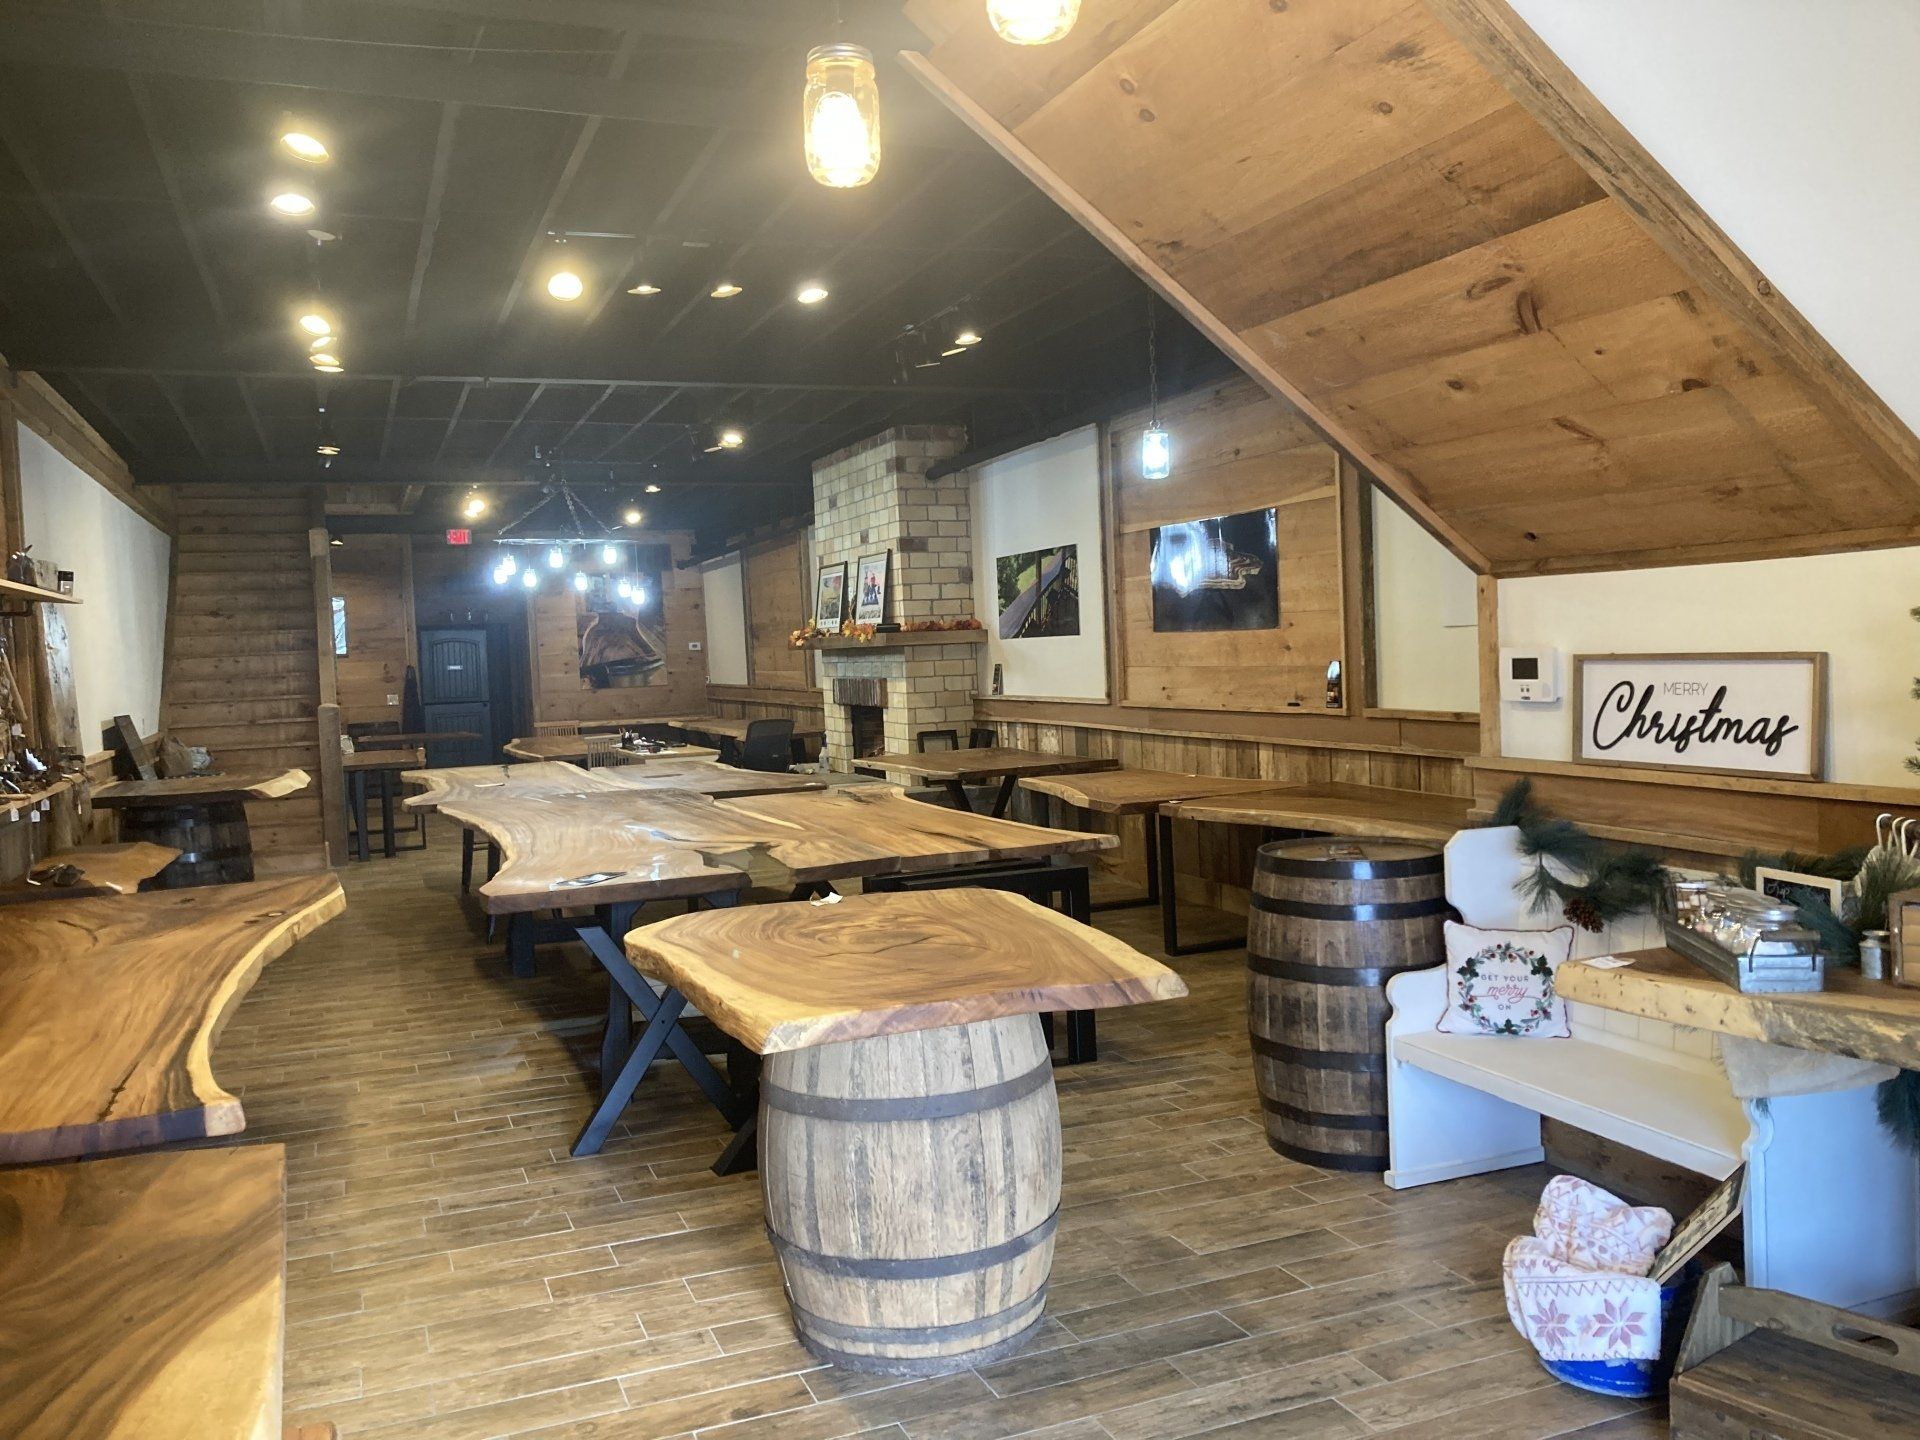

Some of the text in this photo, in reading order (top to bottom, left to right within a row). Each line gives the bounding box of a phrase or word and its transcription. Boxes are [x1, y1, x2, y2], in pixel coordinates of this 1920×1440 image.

[1663, 682, 1709, 696] MERRY
[1592, 680, 1799, 757] Christmas
[1486, 984, 1529, 1004] merry
